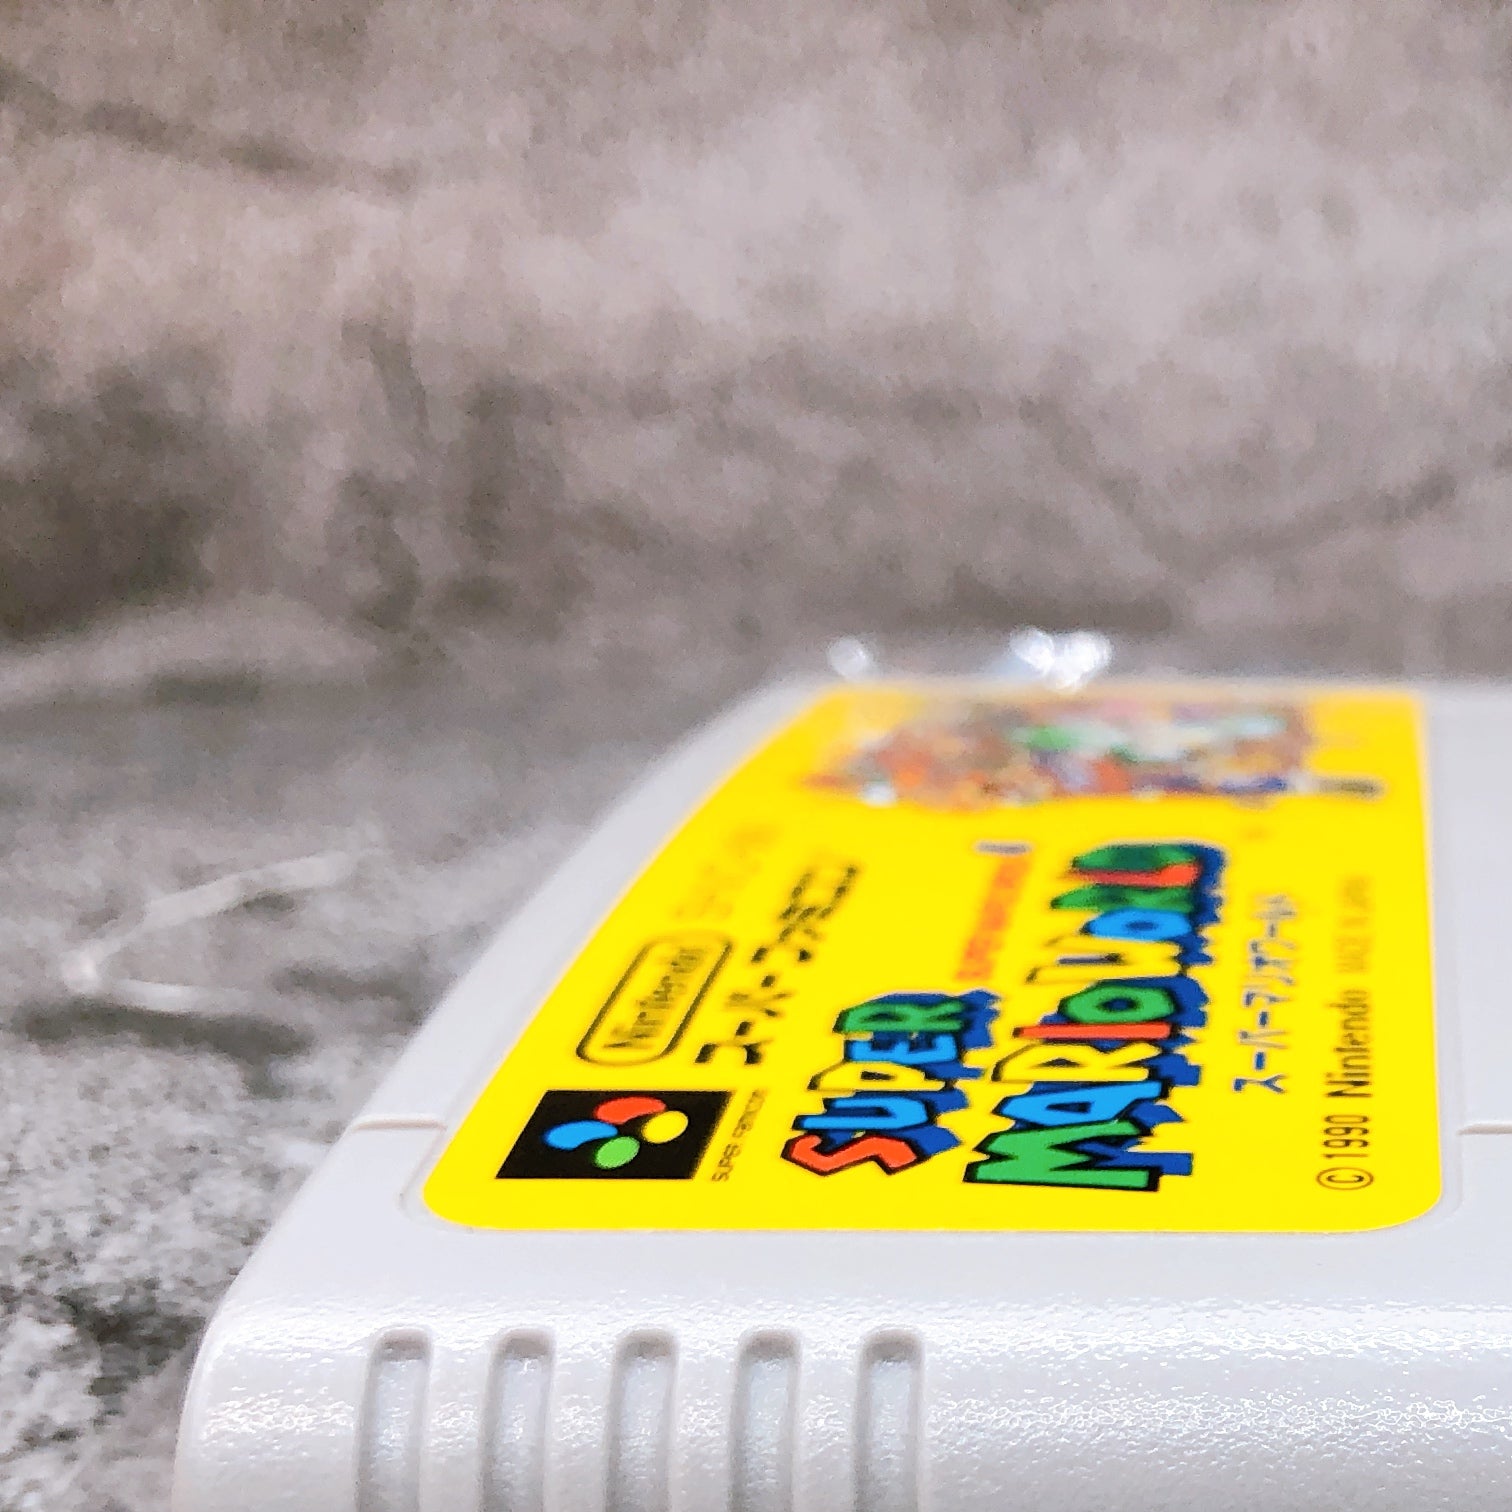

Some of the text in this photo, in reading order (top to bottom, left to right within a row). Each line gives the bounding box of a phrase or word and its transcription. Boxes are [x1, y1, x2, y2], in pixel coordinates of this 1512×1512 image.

[780, 990, 990, 1176] SUPER
[963, 841, 1226, 1192] MARIO WORLD
[1322, 988, 1374, 1099] Nintendo
